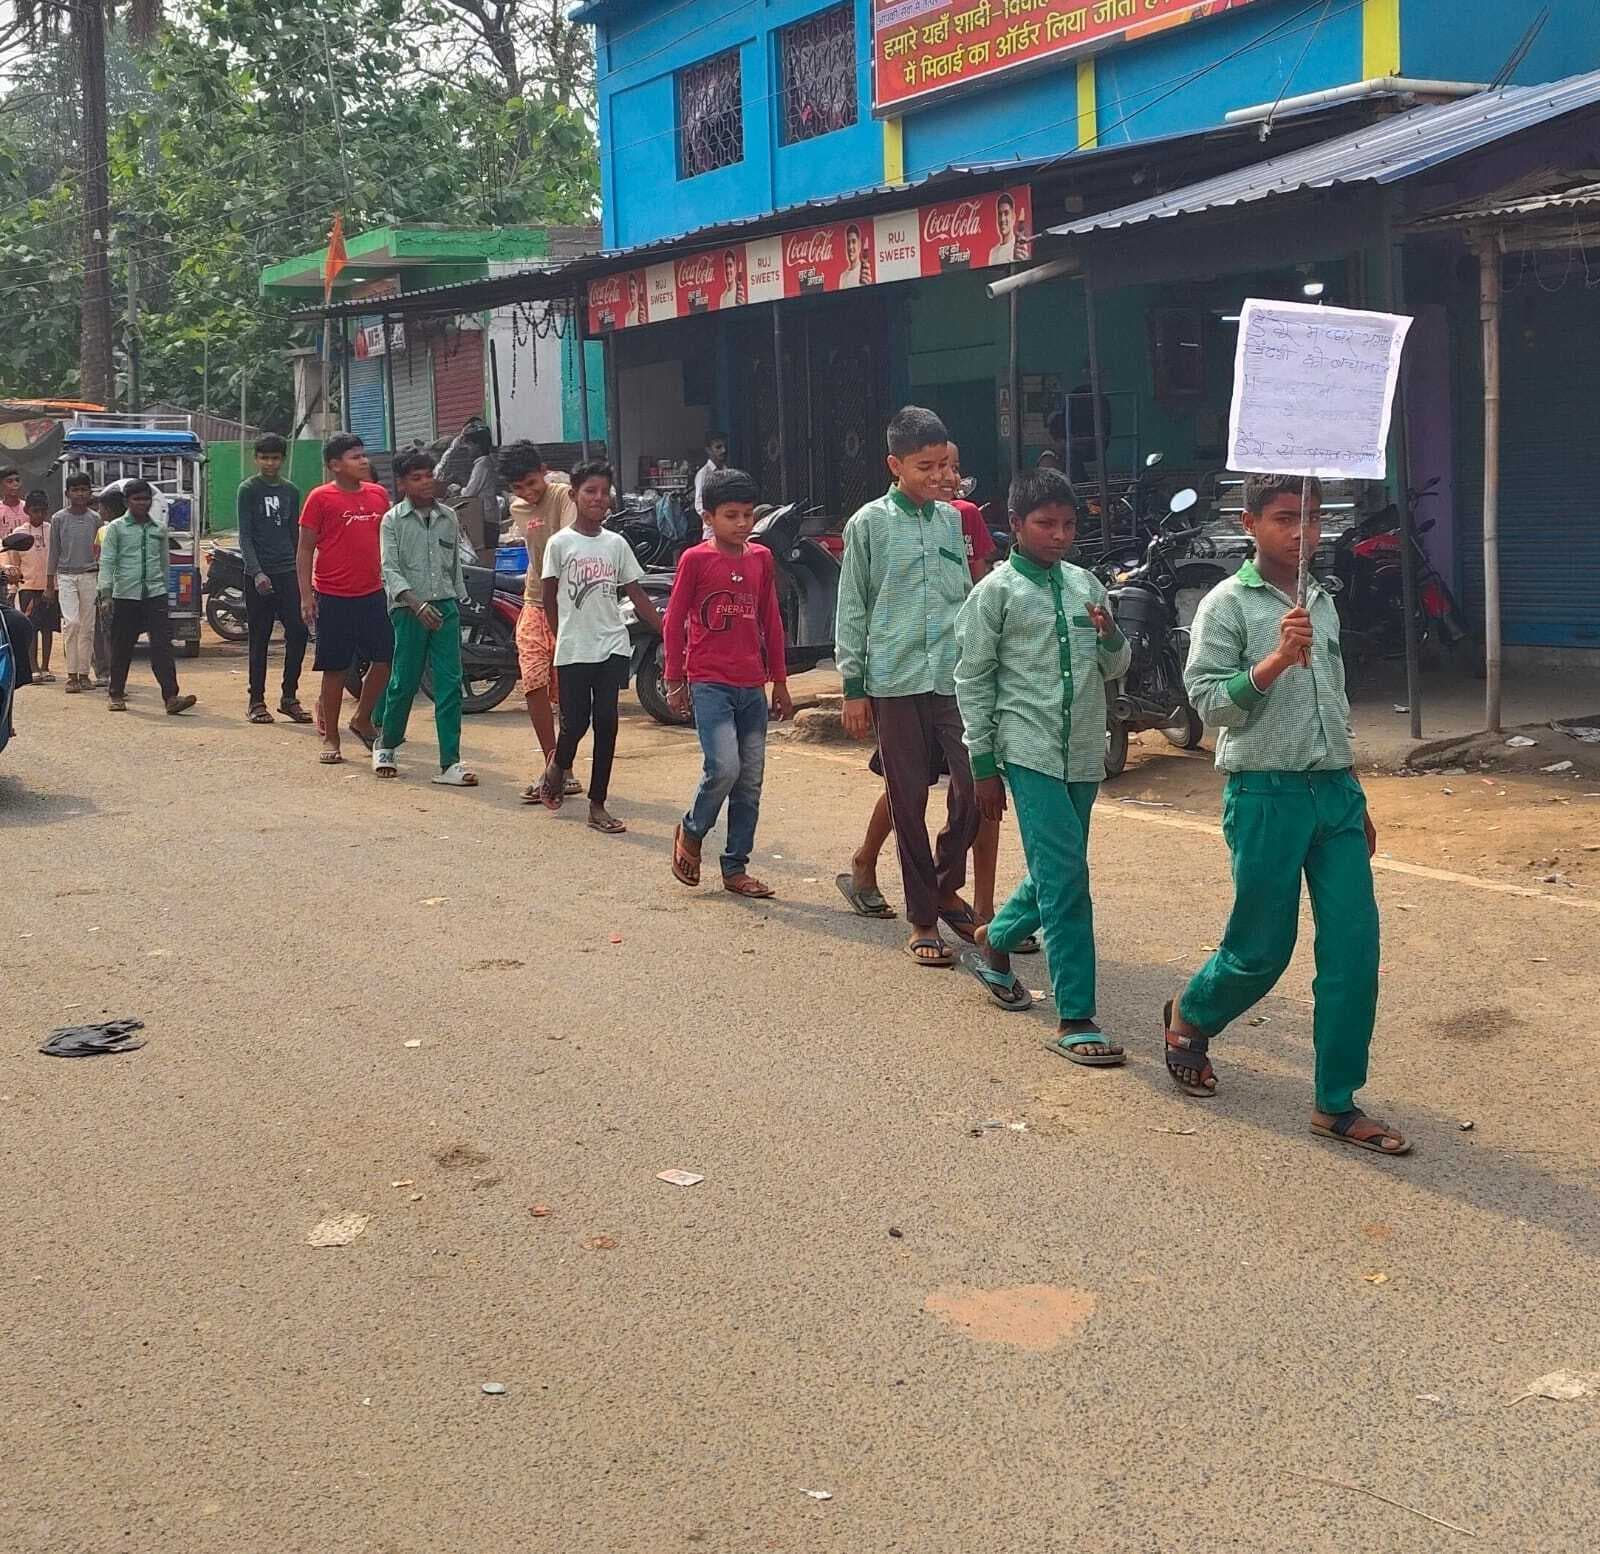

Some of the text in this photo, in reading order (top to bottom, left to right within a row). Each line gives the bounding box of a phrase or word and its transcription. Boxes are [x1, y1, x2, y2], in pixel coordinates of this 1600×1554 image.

[883, 26, 918, 60] हमारे
[921, 13, 950, 45] यहाँ
[904, 60, 916, 85] में
[920, 44, 965, 82] मिठाई
[968, 41, 990, 66] का
[996, 20, 1041, 58] ऑर्डर
[1045, 8, 1087, 42] लिया
[923, 201, 982, 242] Coca-Cola
[888, 231, 905, 244] RUJ
[786, 231, 834, 266] Coca-Cola
[879, 246, 916, 262] SWEETS
[757, 256, 771, 269] RUJ
[751, 271, 780, 286] SWEETS
[651, 293, 674, 305] SWEETS
